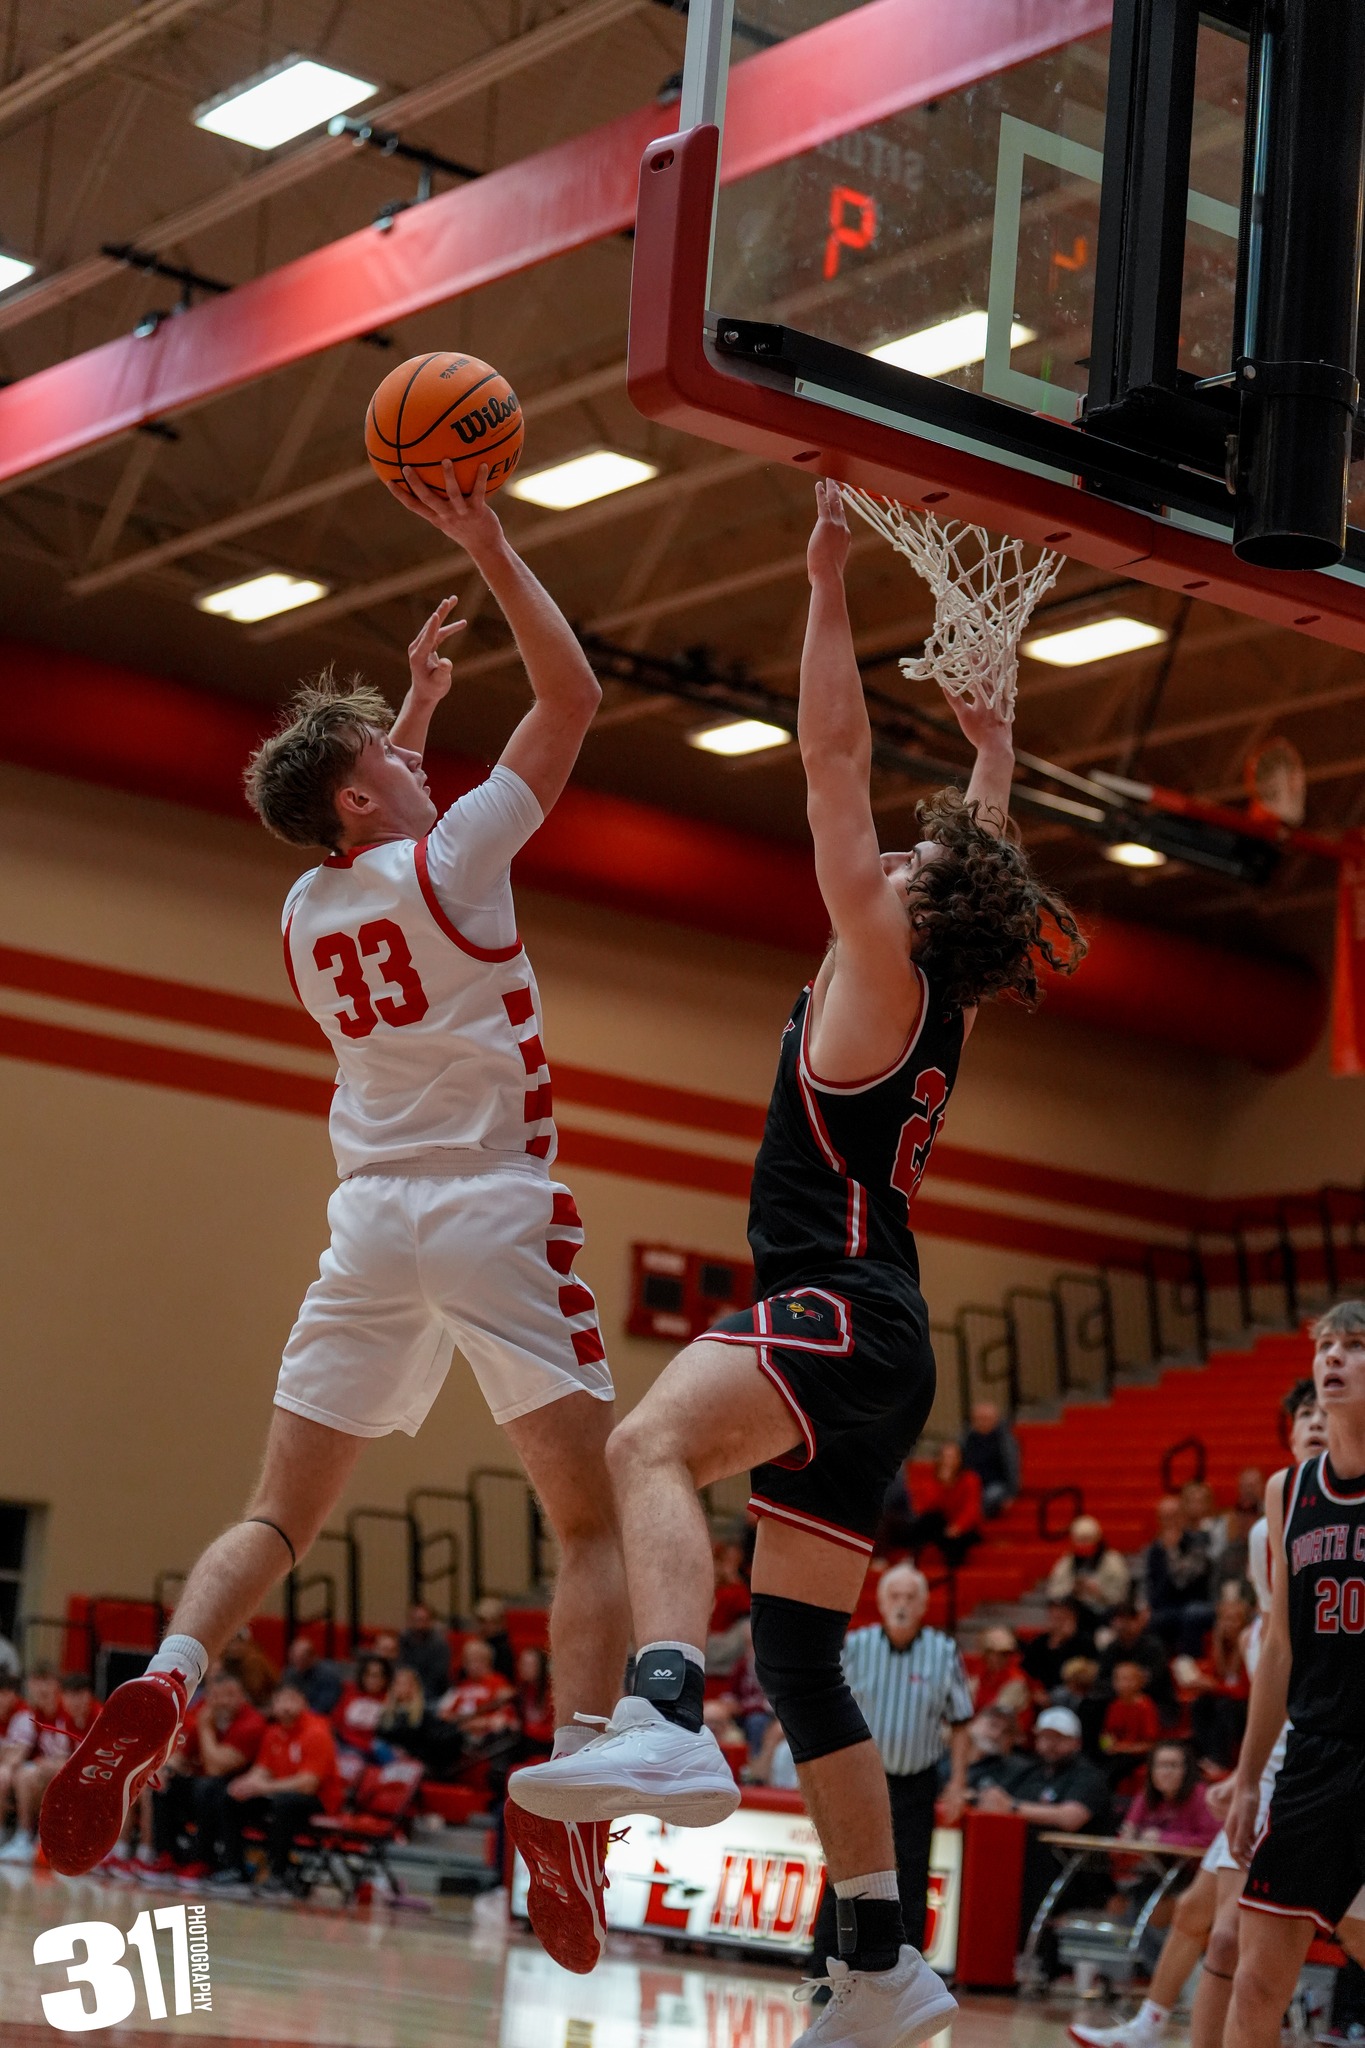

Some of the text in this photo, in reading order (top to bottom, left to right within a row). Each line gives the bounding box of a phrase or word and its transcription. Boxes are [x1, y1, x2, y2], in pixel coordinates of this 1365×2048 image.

[312, 918, 430, 1040] 33
[1292, 1525, 1349, 1576] NORTH
[1314, 1577, 1365, 1634] 20
